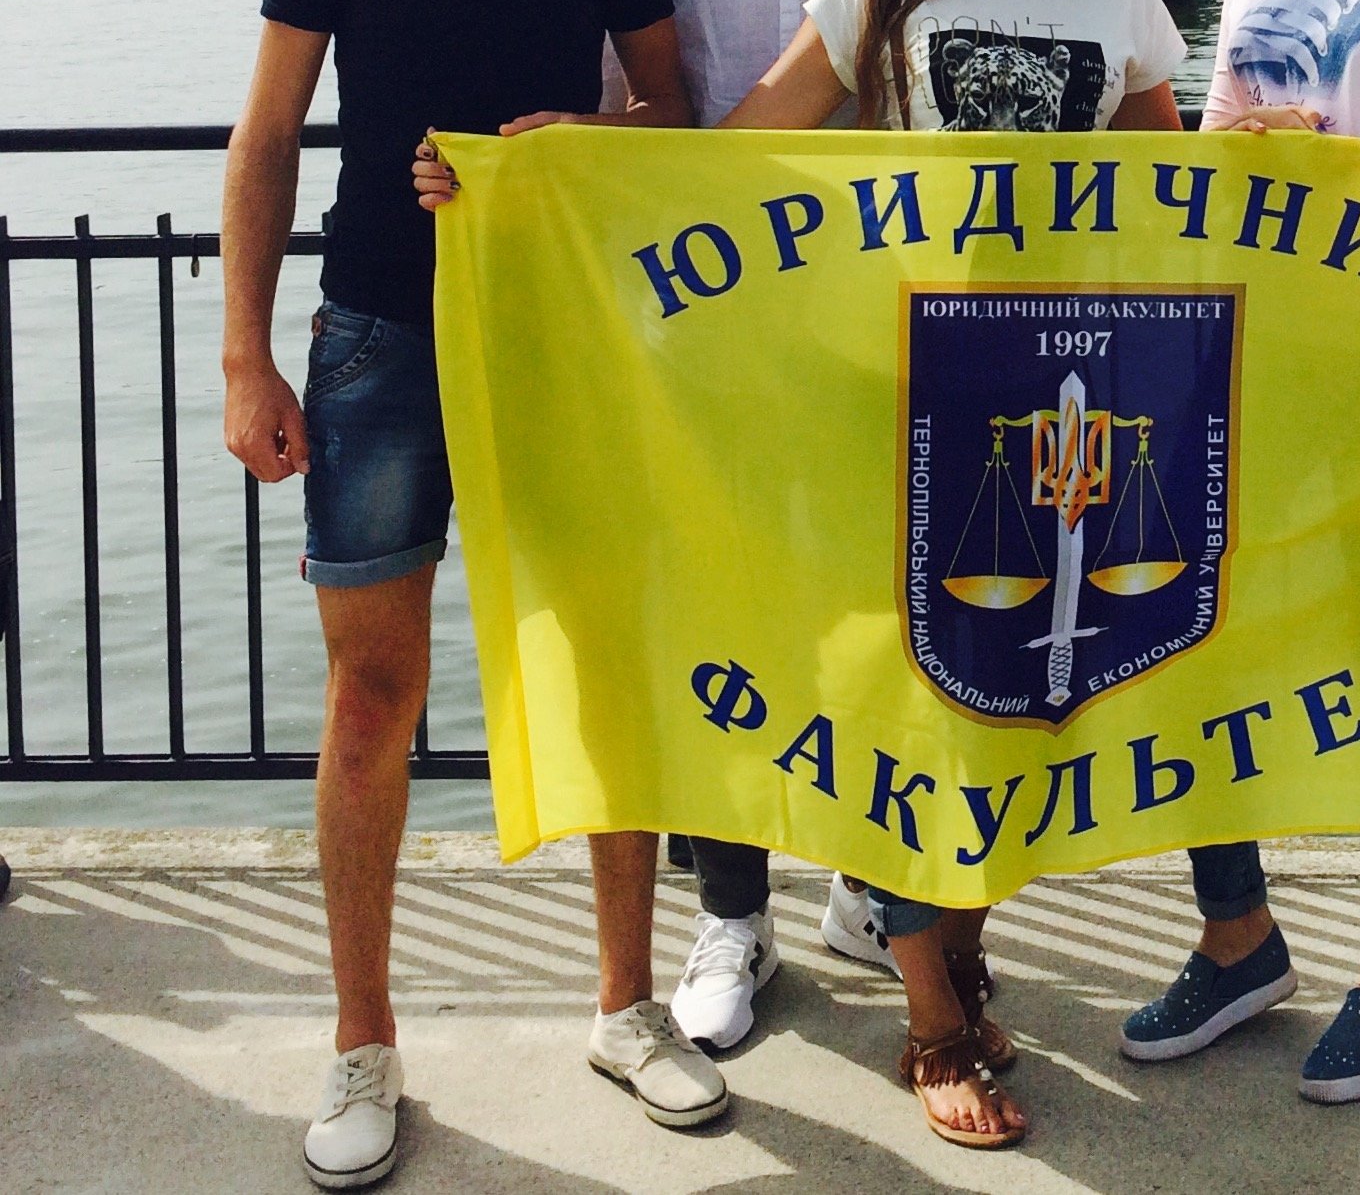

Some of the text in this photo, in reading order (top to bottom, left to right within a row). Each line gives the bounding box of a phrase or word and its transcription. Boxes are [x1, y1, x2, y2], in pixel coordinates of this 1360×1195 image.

[923, 297, 1226, 320] ЮРИДИЧНИЙ ФАКУЛЬТЕТ
[1035, 331, 1112, 357] 1997
[911, 414, 931, 615] ТЕРНОПІЛЬСЬКИЙ
[912, 620, 1030, 713] НАЦІОНАЛЬНИЙ
[1087, 586, 1214, 693] ЕКОНОМІЧНИЙ
